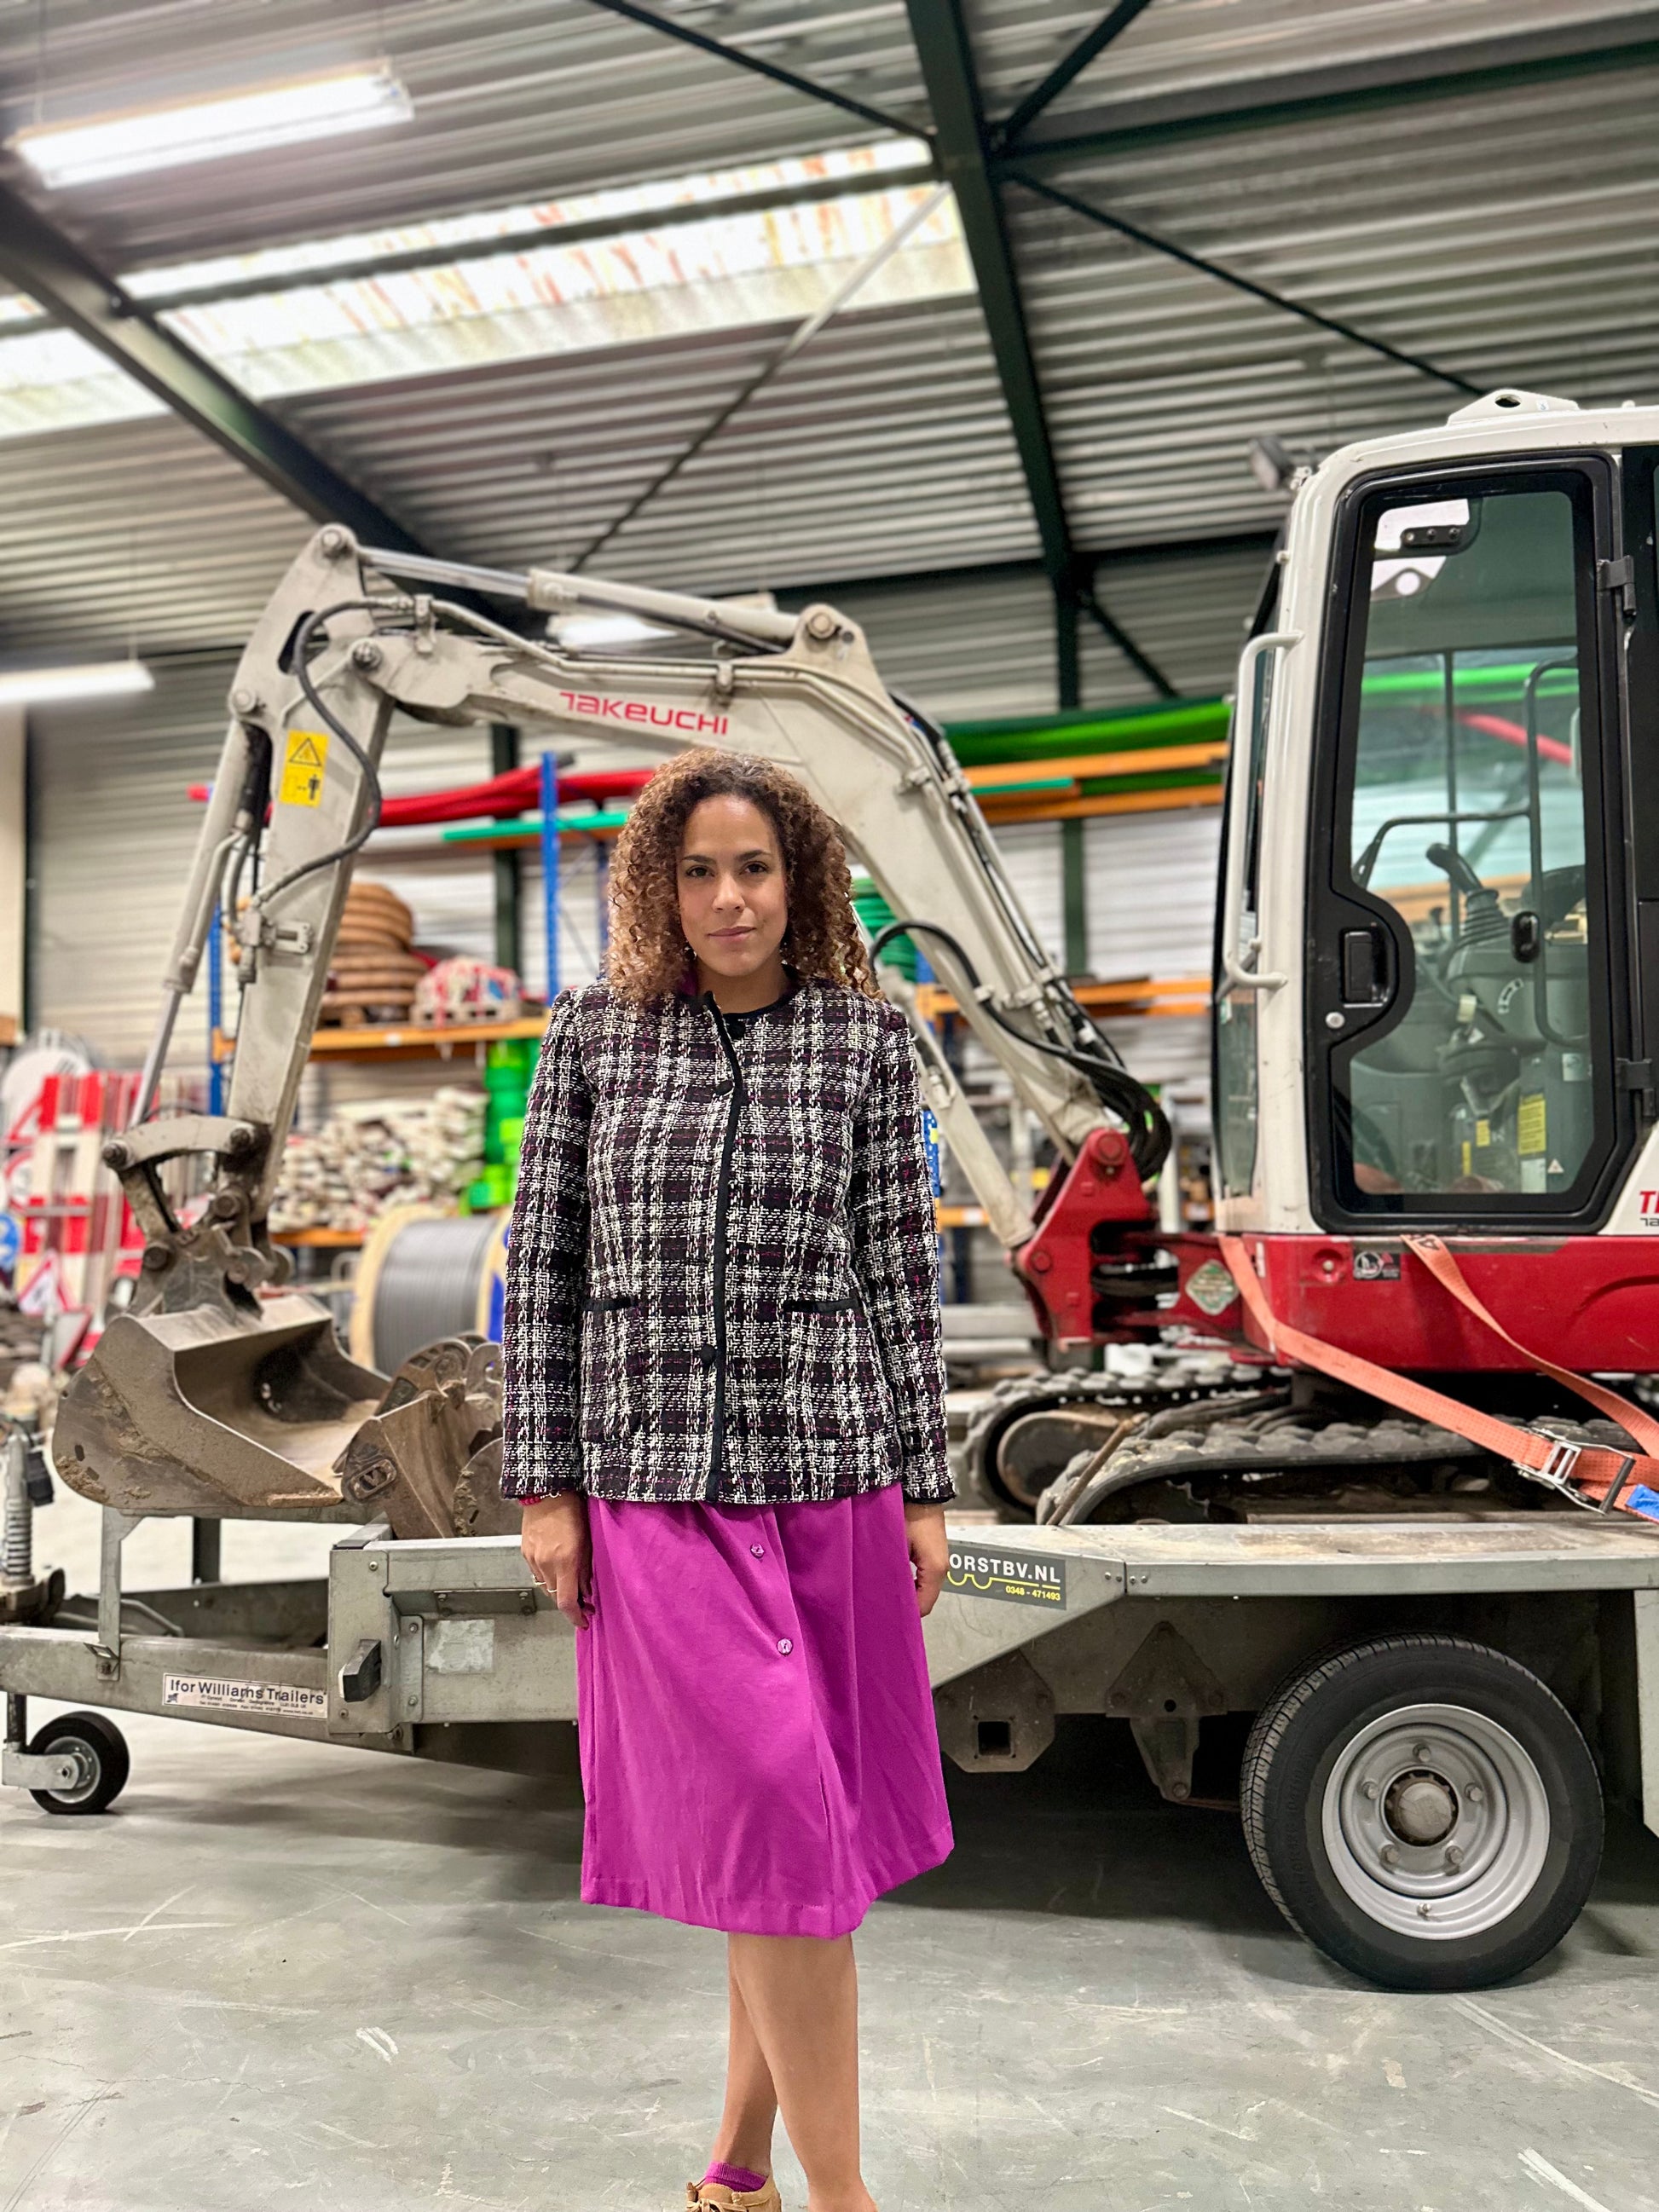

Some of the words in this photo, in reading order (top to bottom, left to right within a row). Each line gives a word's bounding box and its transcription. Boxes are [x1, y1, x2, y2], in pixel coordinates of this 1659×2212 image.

[1639, 1190, 1659, 1214] T
[949, 1553, 1061, 1584] ORSTBV.NL
[1005, 1585, 1025, 1597] 0348
[1032, 1589, 1061, 1602] 471493
[171, 1678, 196, 1694] Ifor
[199, 1681, 264, 1700] Williams
[267, 1687, 325, 1705] Trailers
